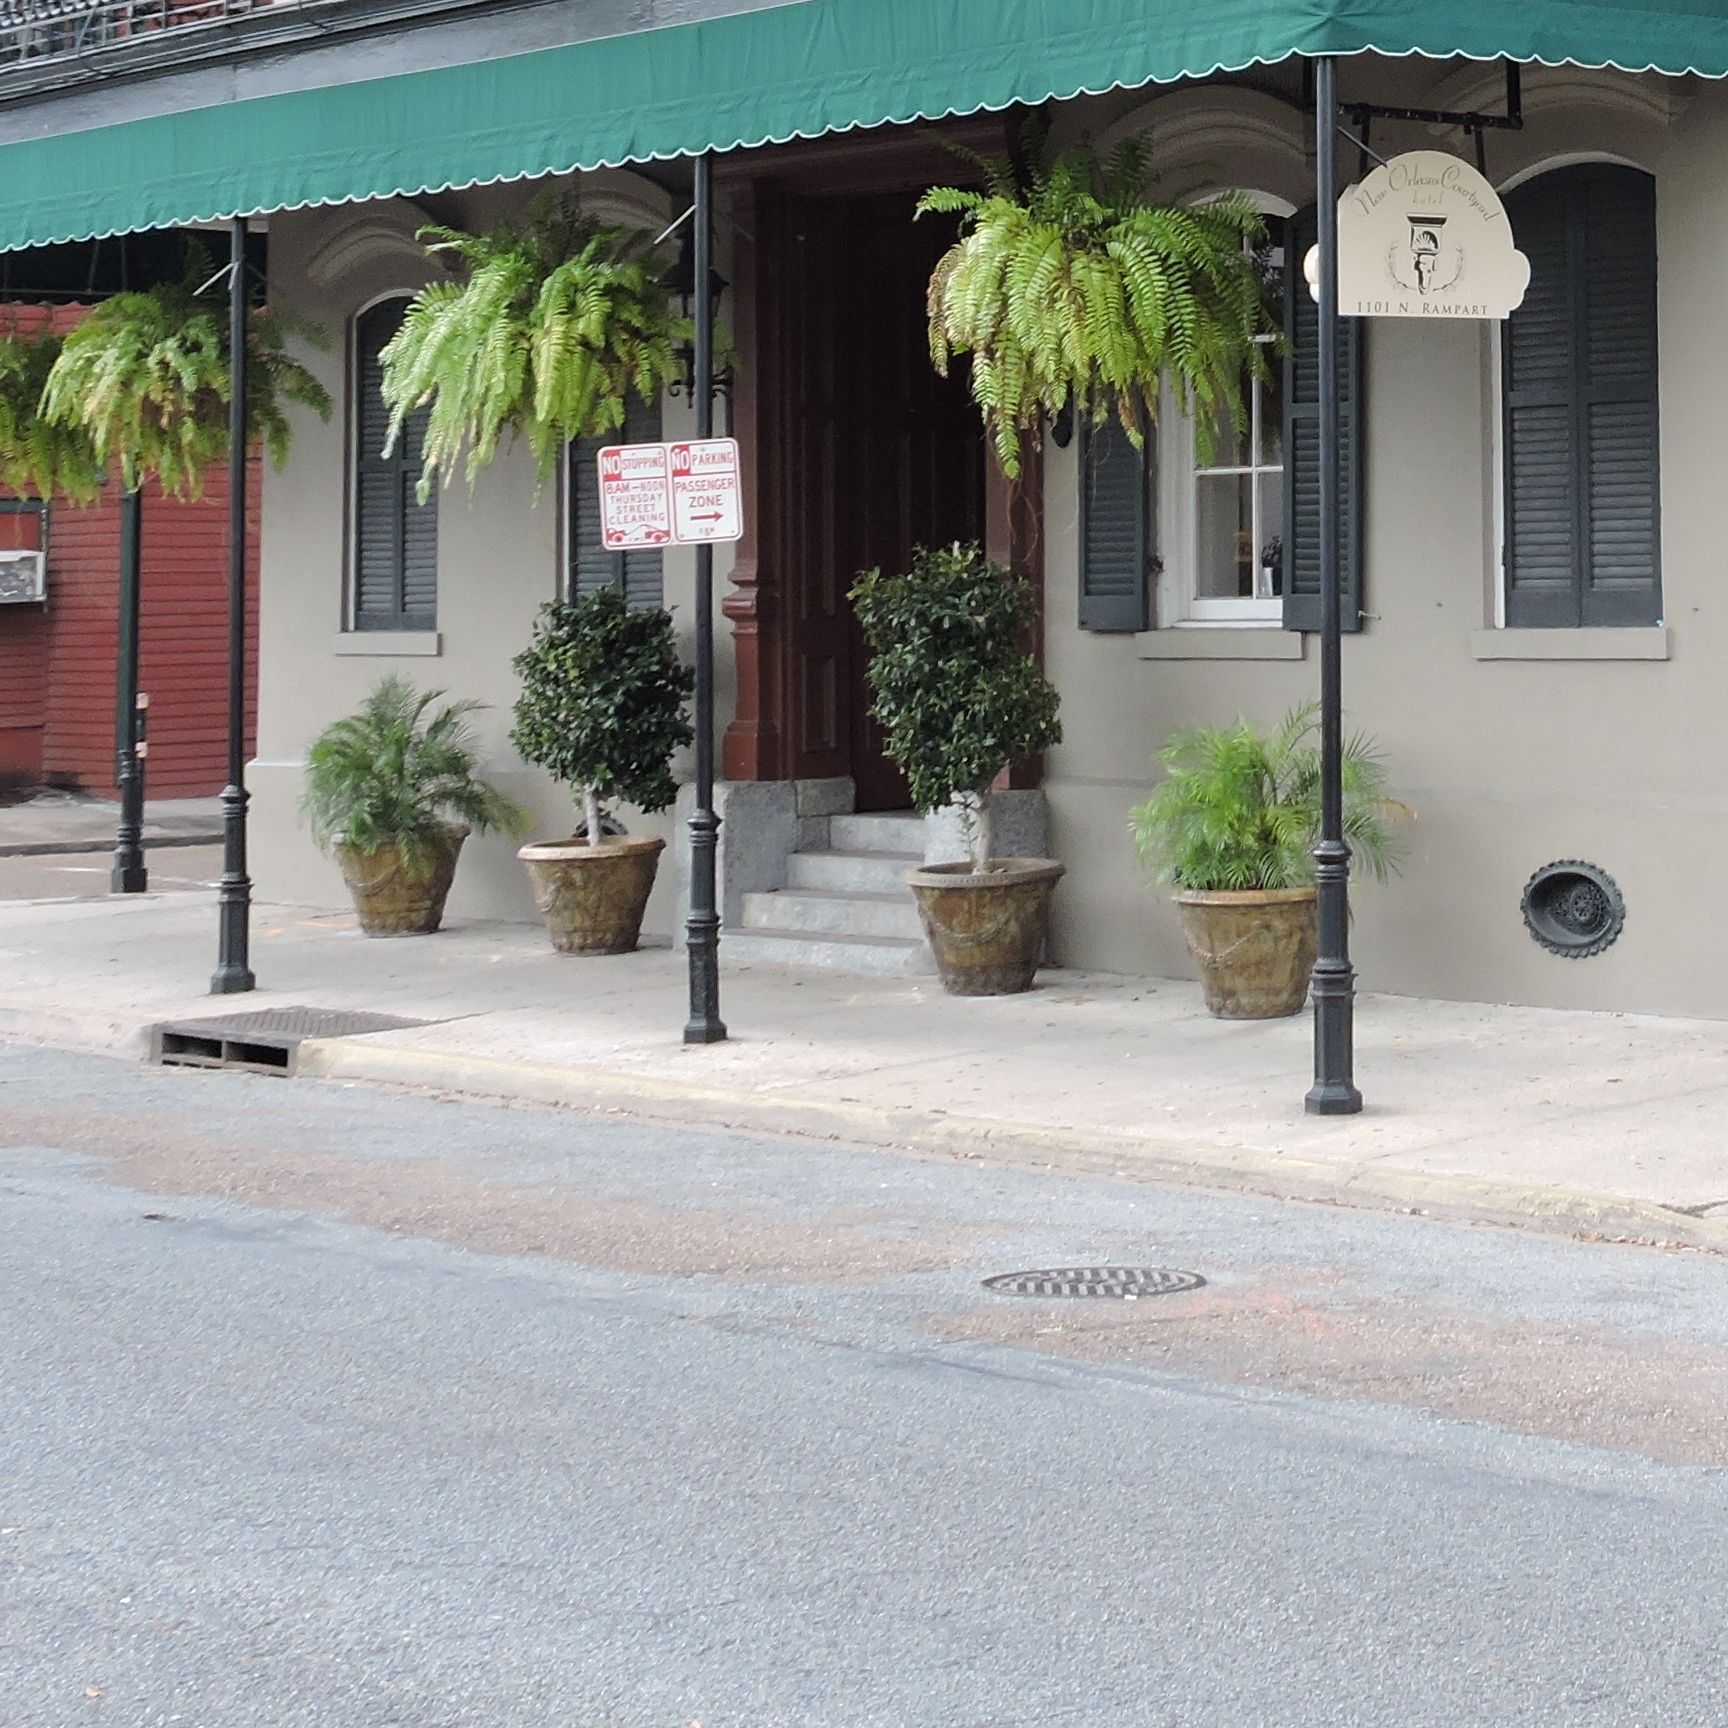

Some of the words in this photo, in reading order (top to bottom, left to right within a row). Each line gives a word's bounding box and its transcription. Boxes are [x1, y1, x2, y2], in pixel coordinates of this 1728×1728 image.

[1352, 189, 1388, 217] New
[1388, 163, 1440, 192] Orleans
[1441, 164, 1501, 222] Courtyard
[1411, 190, 1444, 205] hotel
[1357, 301, 1390, 313] 1101
[1398, 302, 1415, 314] N.
[1422, 303, 1488, 316] RAMPART
[602, 455, 621, 476] NO
[621, 456, 665, 471] STOPPING
[671, 449, 691, 472] NO
[691, 451, 735, 466] PARKING
[674, 477, 736, 494] PASSENGER
[610, 493, 663, 504] THURSDAY
[688, 494, 725, 509] ZONE
[616, 503, 655, 515] STREET
[608, 512, 666, 525] CLEANING
